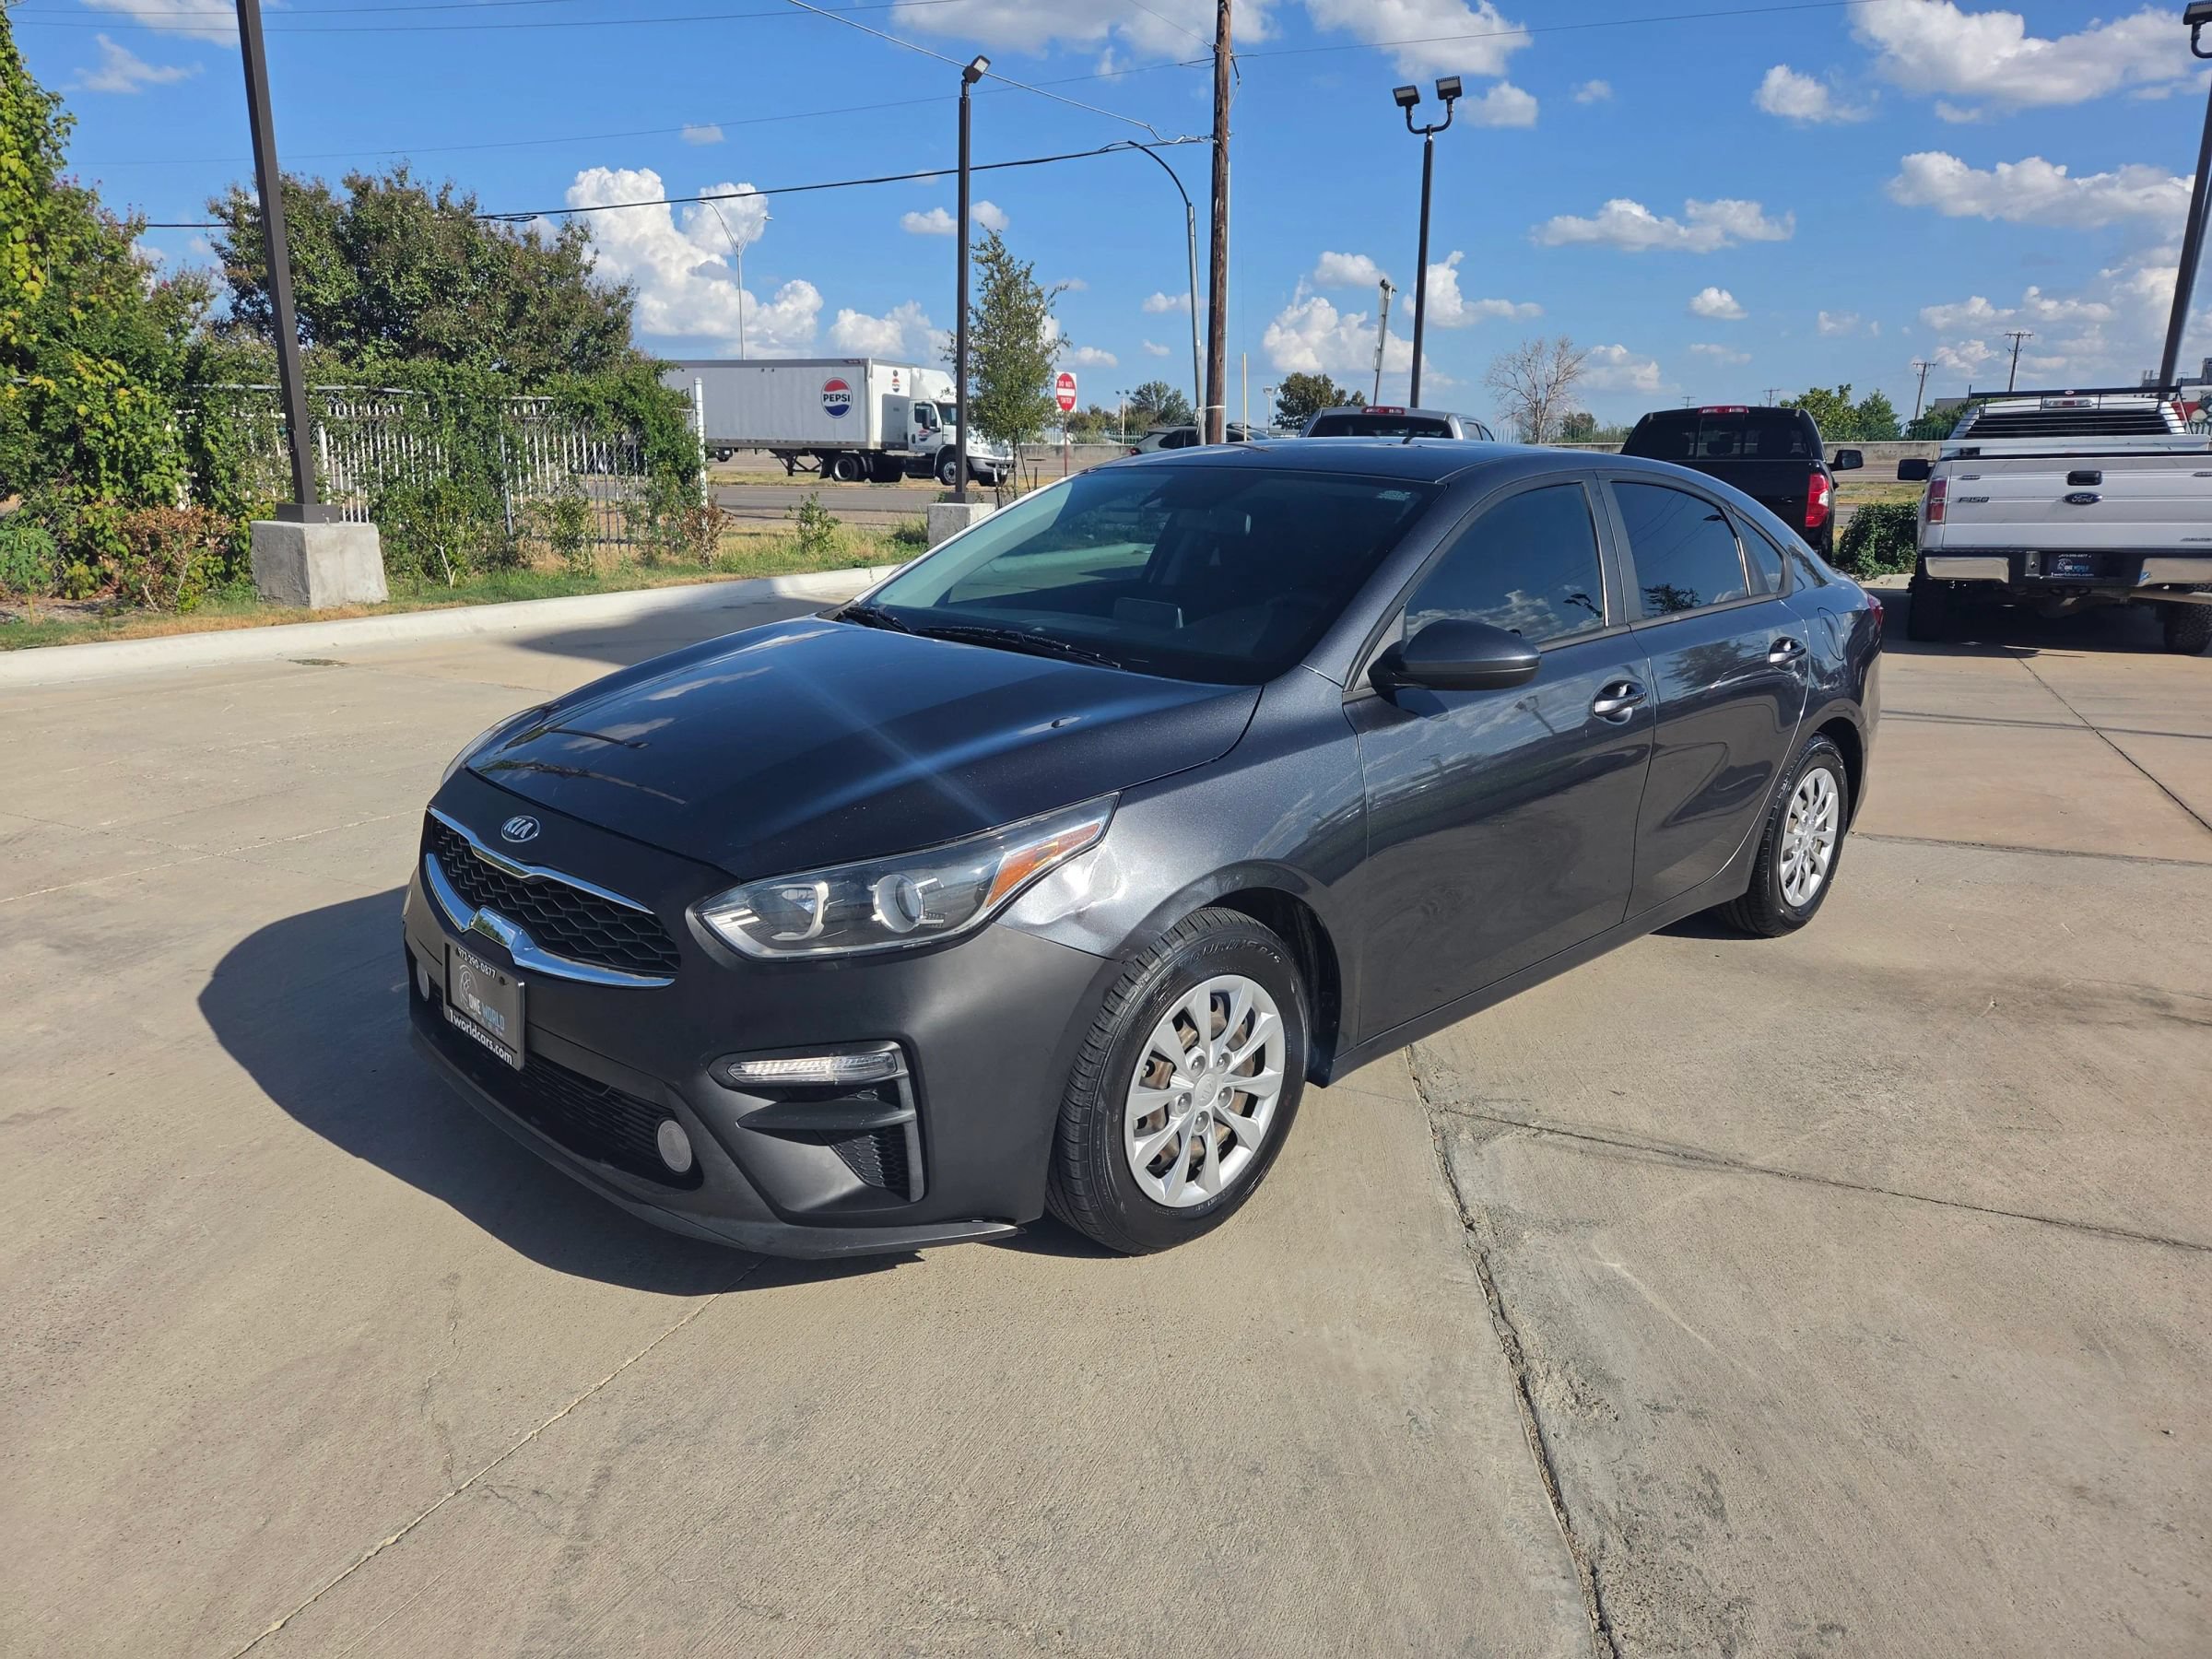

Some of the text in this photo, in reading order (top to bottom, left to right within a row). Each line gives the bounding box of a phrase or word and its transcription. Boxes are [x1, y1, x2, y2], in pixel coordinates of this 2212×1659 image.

[823, 394, 851, 403] PEPSI
[2071, 494, 2094, 503] Ford
[503, 817, 534, 839] KIA
[468, 993, 505, 1030] ONE WORLD
[449, 1008, 513, 1065] 1worldcars.com
